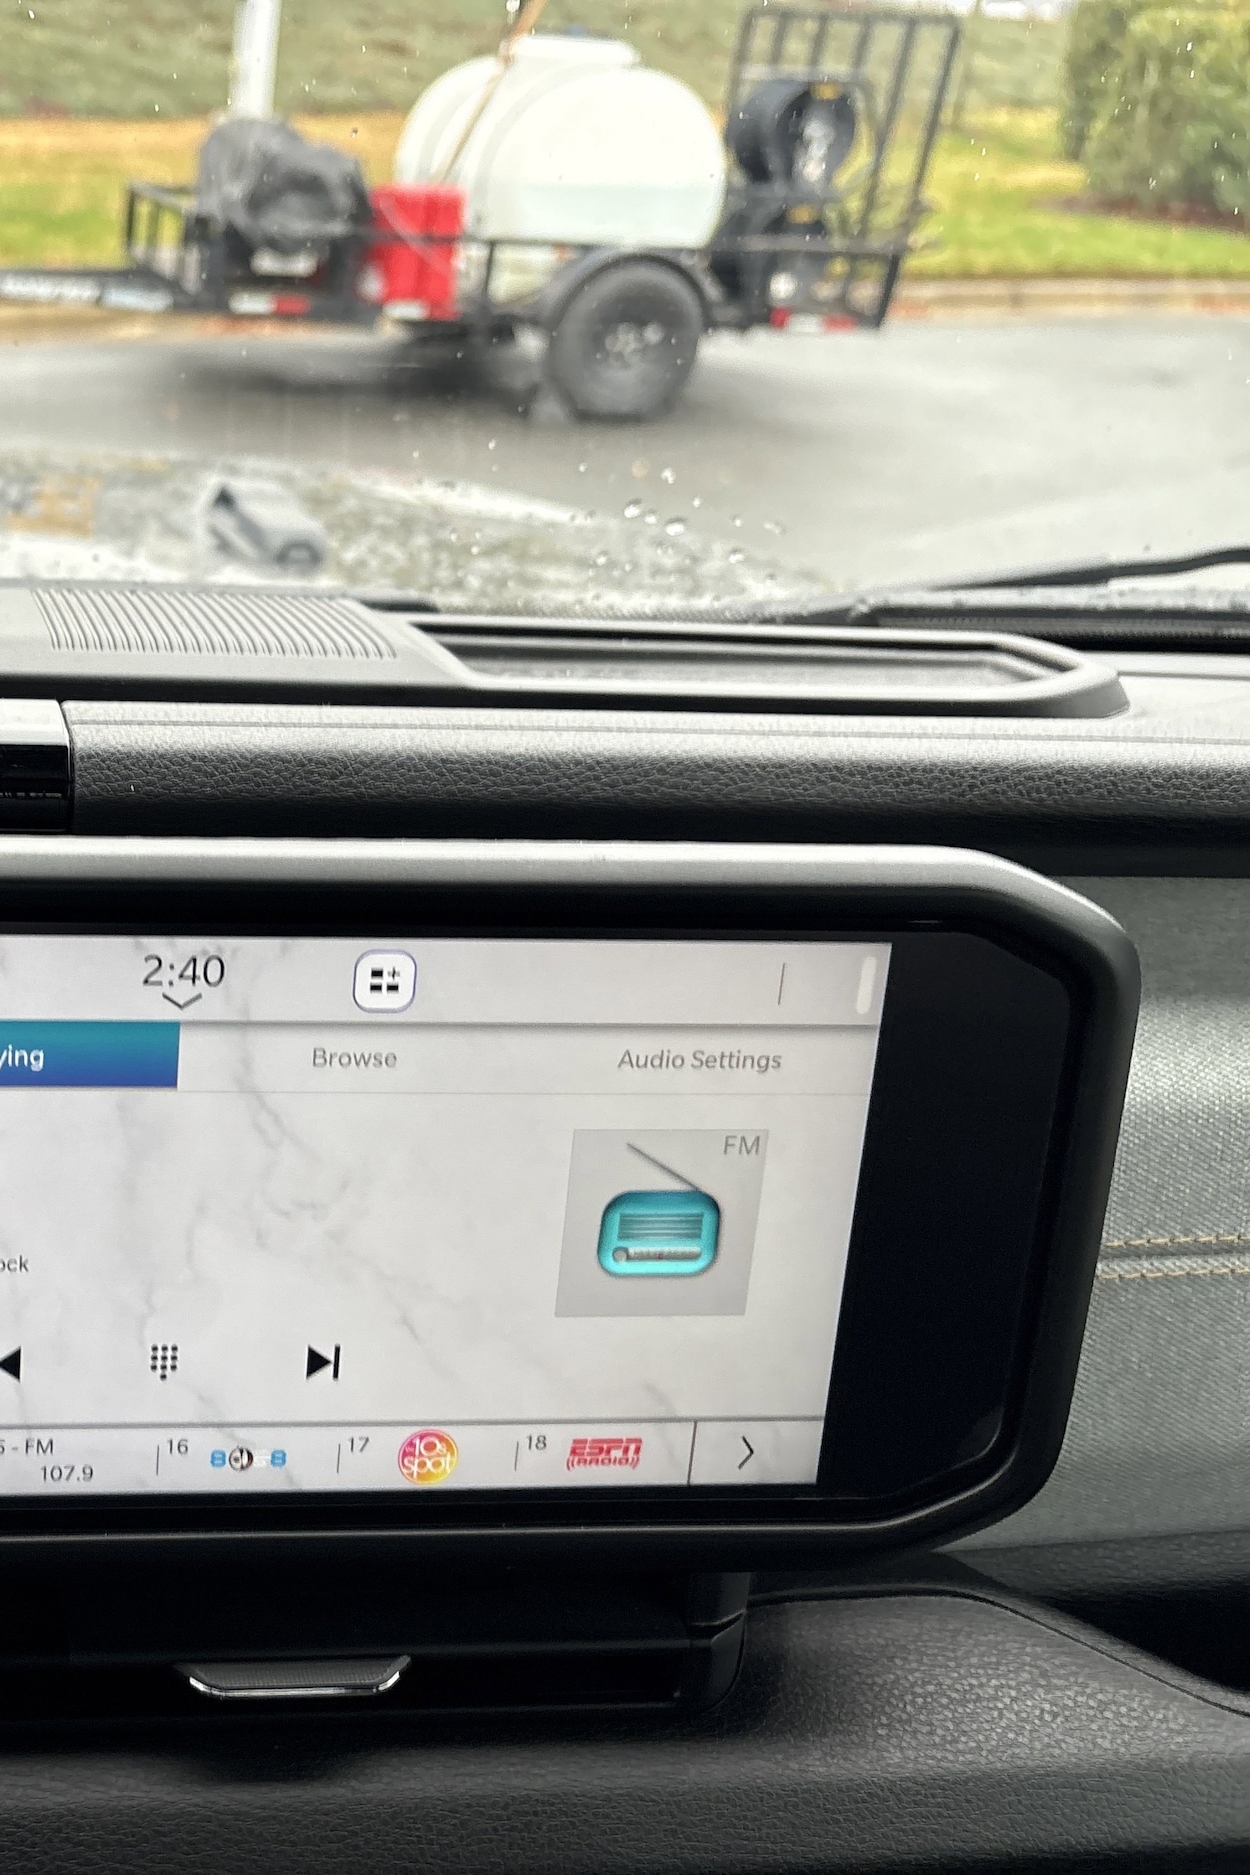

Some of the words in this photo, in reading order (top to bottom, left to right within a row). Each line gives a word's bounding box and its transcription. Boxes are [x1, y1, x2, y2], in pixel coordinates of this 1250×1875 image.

[141, 953, 227, 987] 2:40
[311, 1045, 399, 1069] Browse
[617, 1047, 686, 1070] Audio
[689, 1047, 783, 1075] Settings
[722, 1133, 762, 1157] FM
[24, 1437, 55, 1456] FM
[167, 1438, 190, 1456] 16
[348, 1435, 371, 1453] 17
[526, 1433, 548, 1452] 18
[569, 1438, 644, 1457] ESPN
[40, 1465, 95, 1482] 107.9
[403, 1452, 452, 1478] spot
